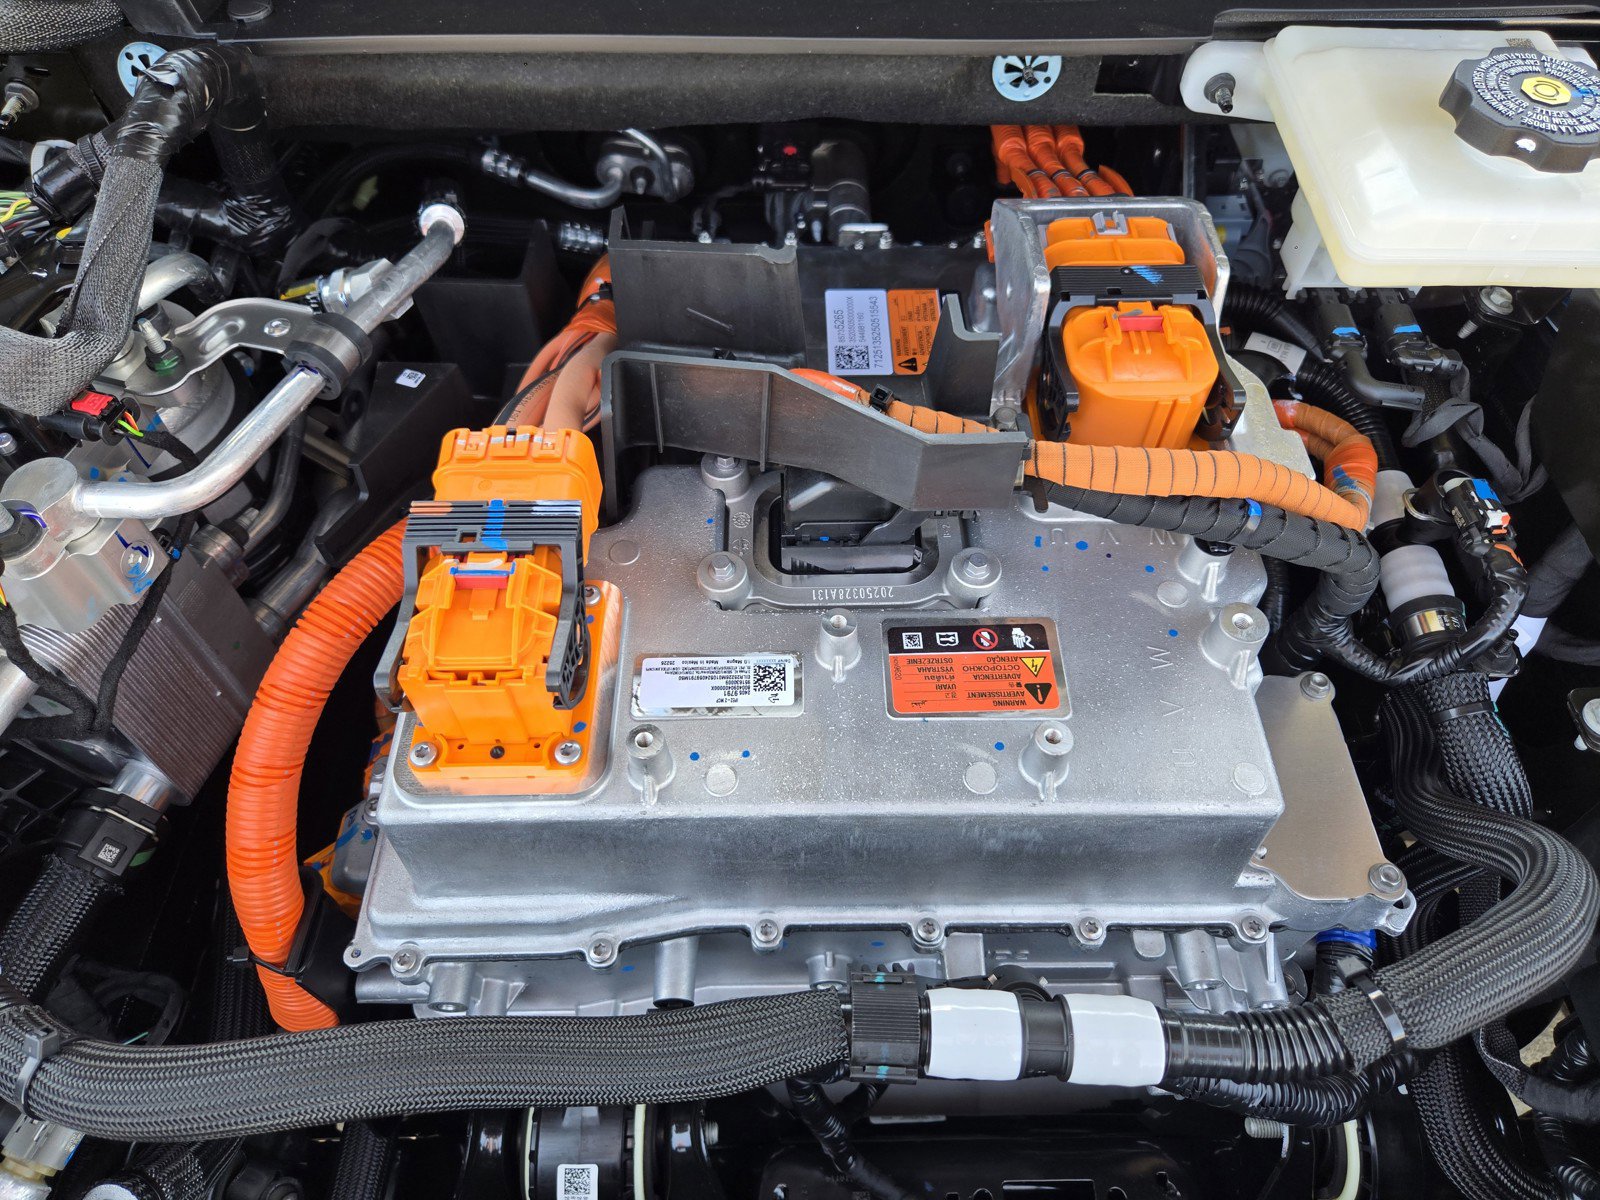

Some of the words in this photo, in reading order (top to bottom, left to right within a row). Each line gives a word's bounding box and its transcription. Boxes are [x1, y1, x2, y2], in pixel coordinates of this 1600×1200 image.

[1527, 110, 1550, 124] DOT4
[811, 587, 895, 602] 20250328A131
[986, 654, 1019, 665] ATENÇÃO
[962, 664, 1020, 672] ОСТОРОЖНО
[966, 690, 1025, 699] AVERTISSEMENT
[992, 698, 1028, 707] WARNING
